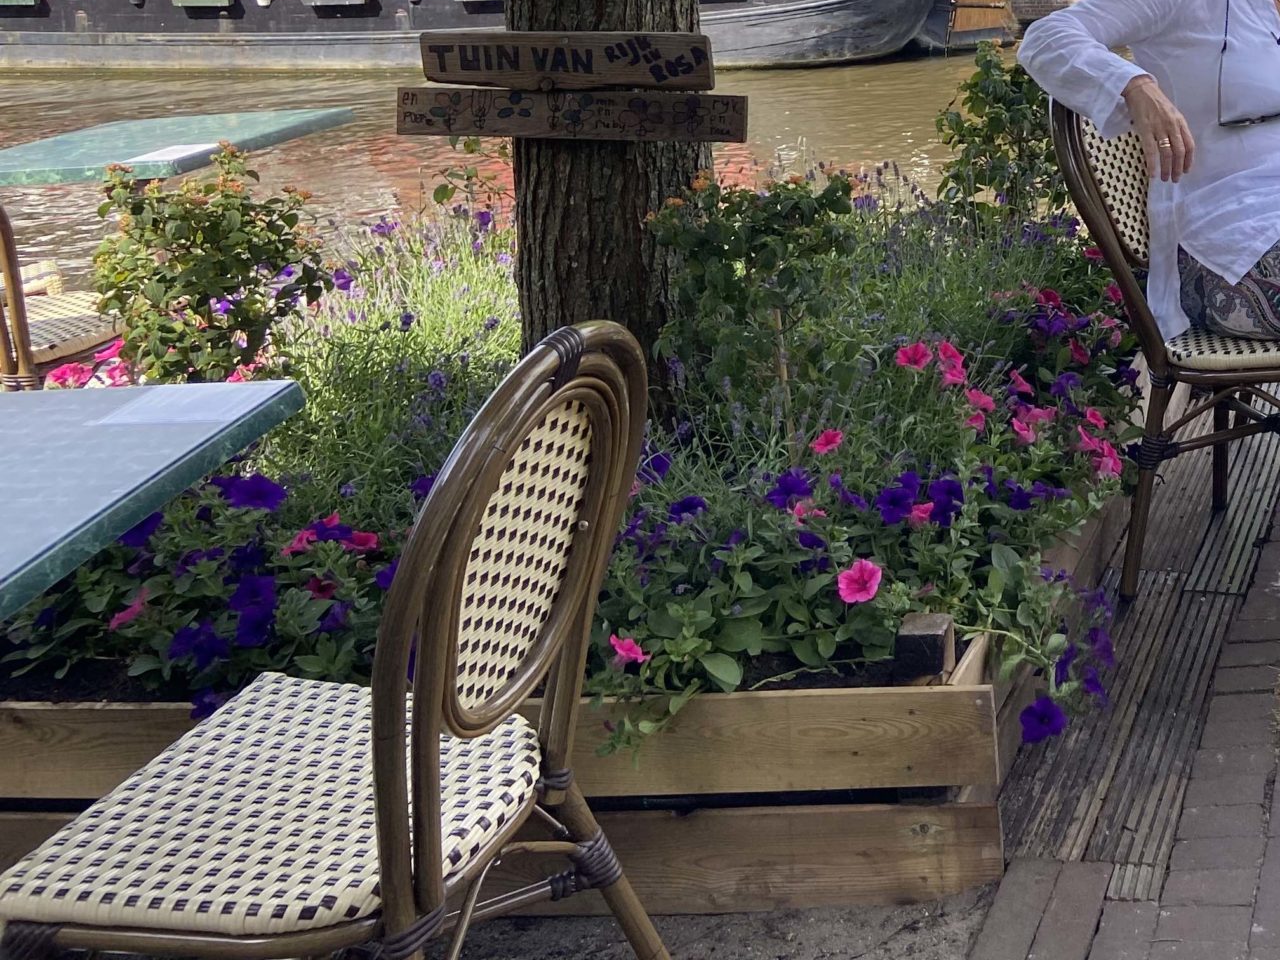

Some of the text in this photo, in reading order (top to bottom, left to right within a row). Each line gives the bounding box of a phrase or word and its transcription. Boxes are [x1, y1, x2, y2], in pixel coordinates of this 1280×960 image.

[428, 44, 594, 74] TUIN VAN
[649, 46, 708, 83] ROSA
[402, 91, 418, 106] en
